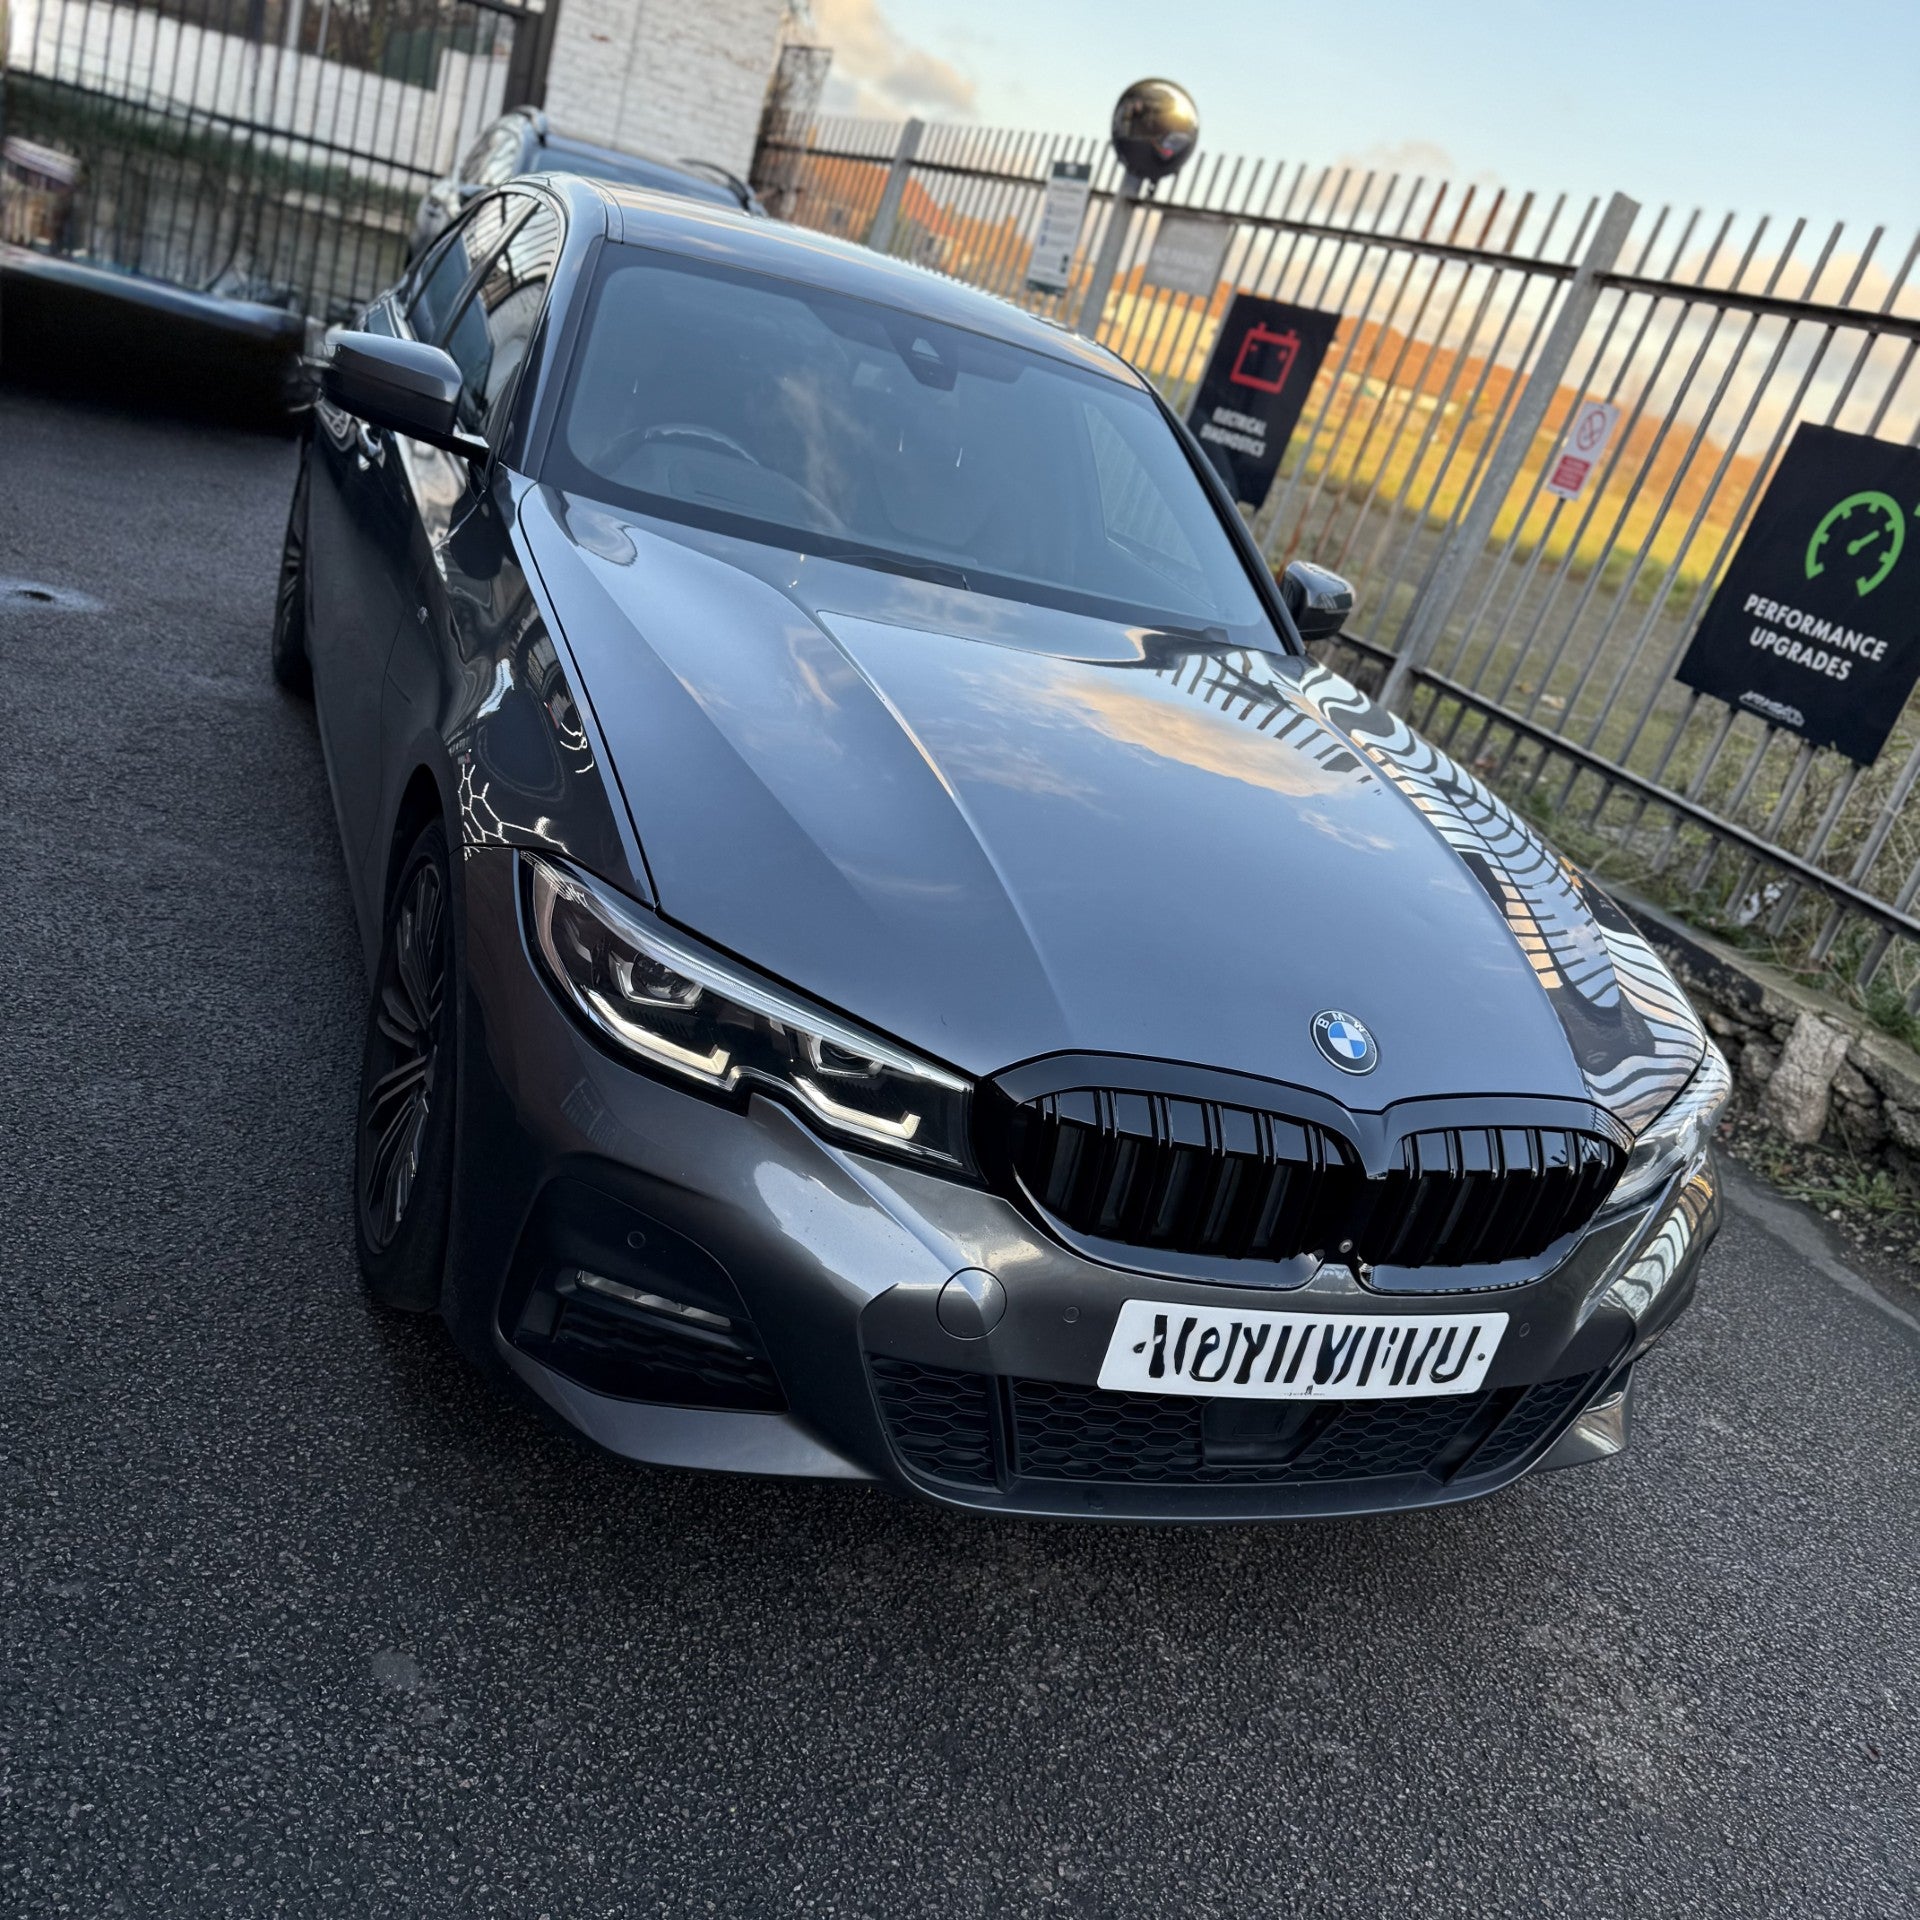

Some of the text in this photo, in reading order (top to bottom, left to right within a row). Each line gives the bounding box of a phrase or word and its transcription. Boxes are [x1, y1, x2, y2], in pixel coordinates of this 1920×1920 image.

[1743, 594, 1888, 662] PERFORMANCE
[1749, 626, 1853, 680] UPGRADES
[1316, 1012, 1366, 1033] BMW
